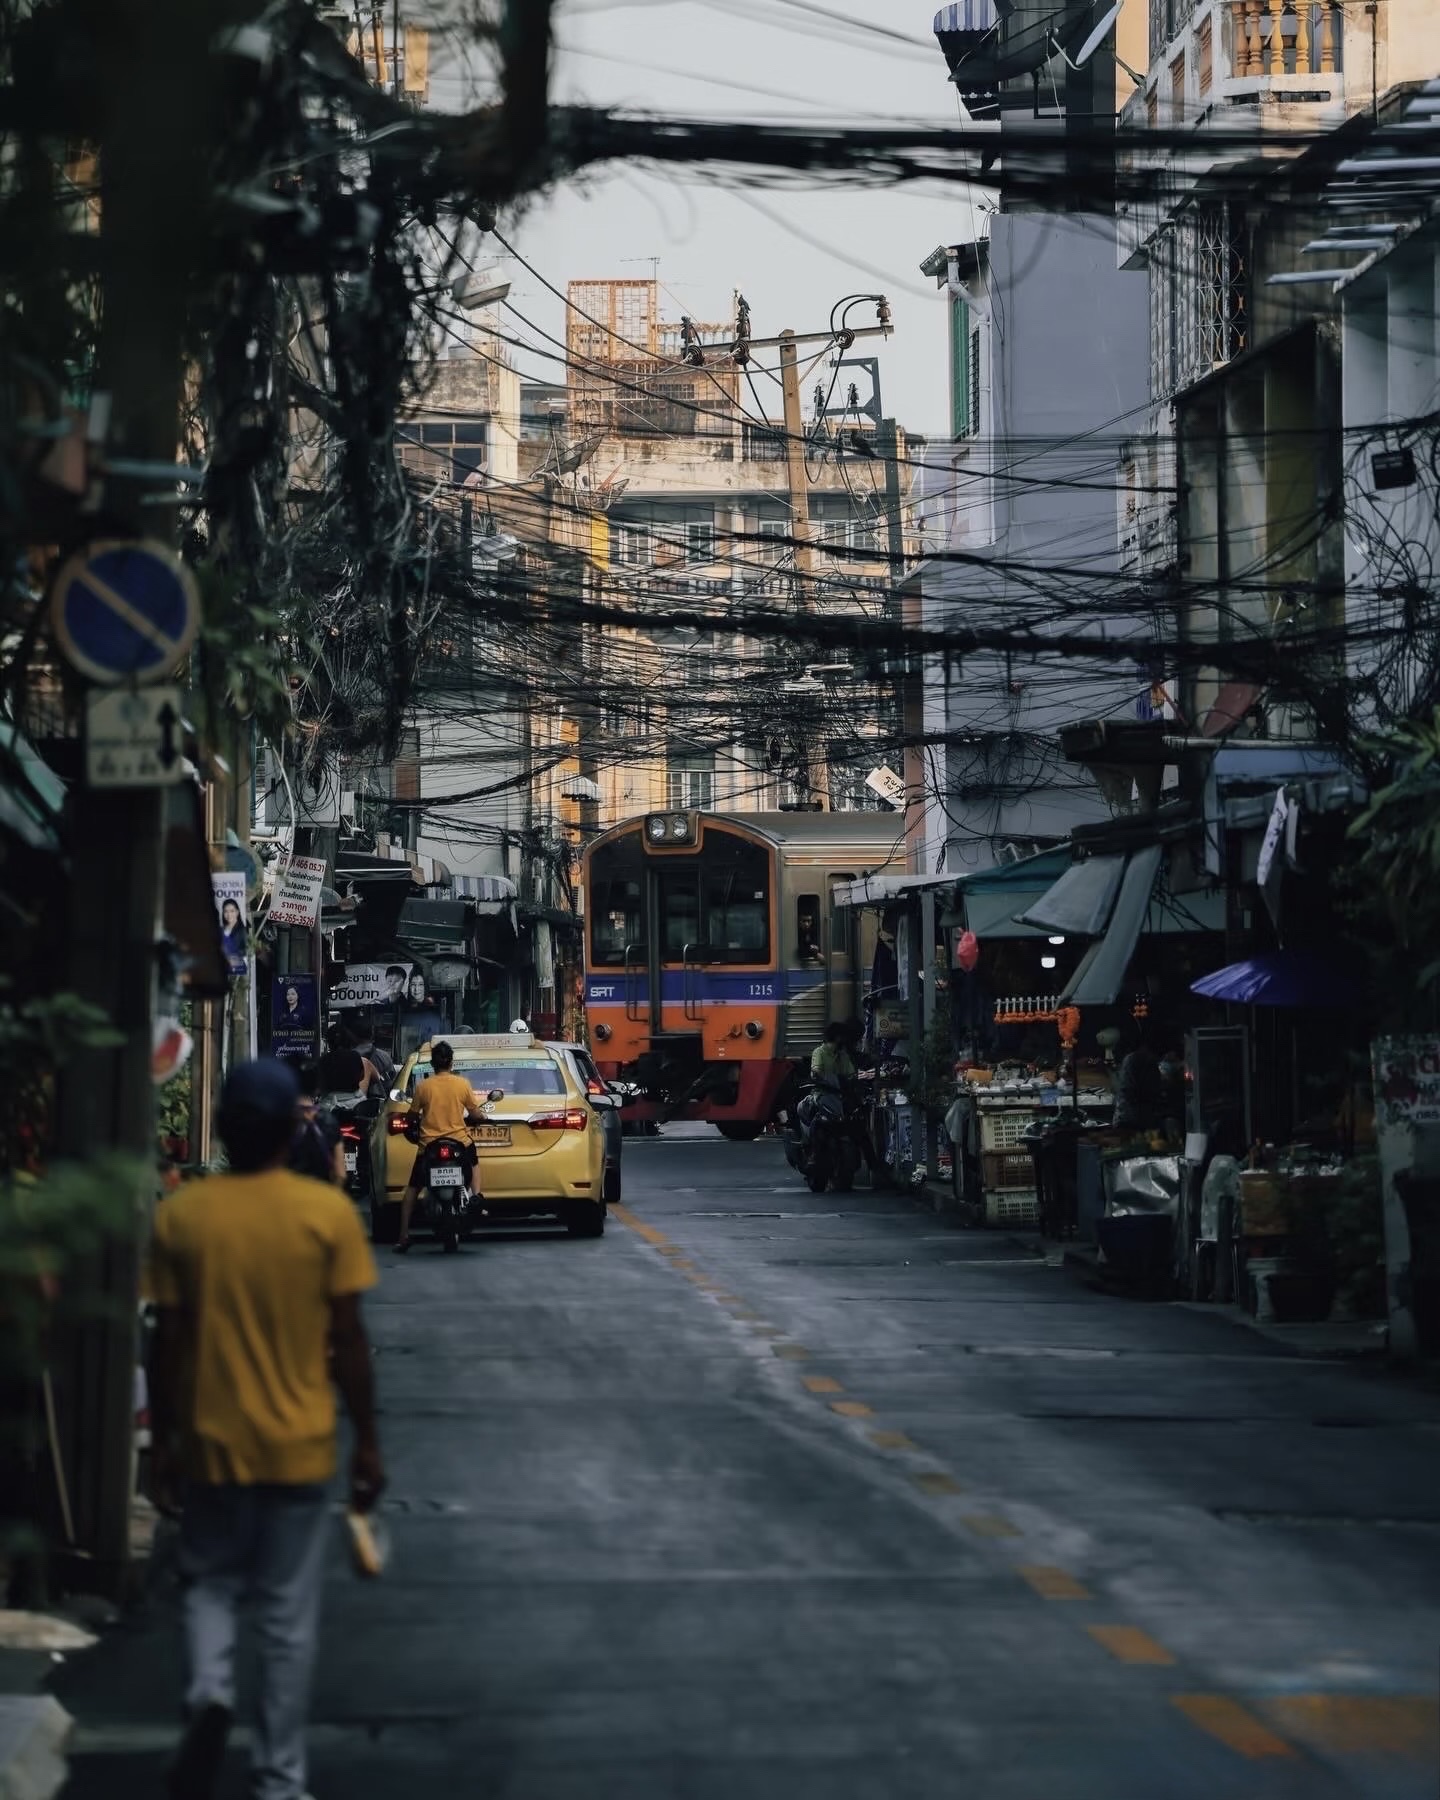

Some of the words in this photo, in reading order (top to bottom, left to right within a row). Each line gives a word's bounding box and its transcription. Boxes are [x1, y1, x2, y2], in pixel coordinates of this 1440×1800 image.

[269, 911, 315, 927] 064-265-3526
[590, 986, 615, 997] SRT
[749, 984, 772, 996] 1215
